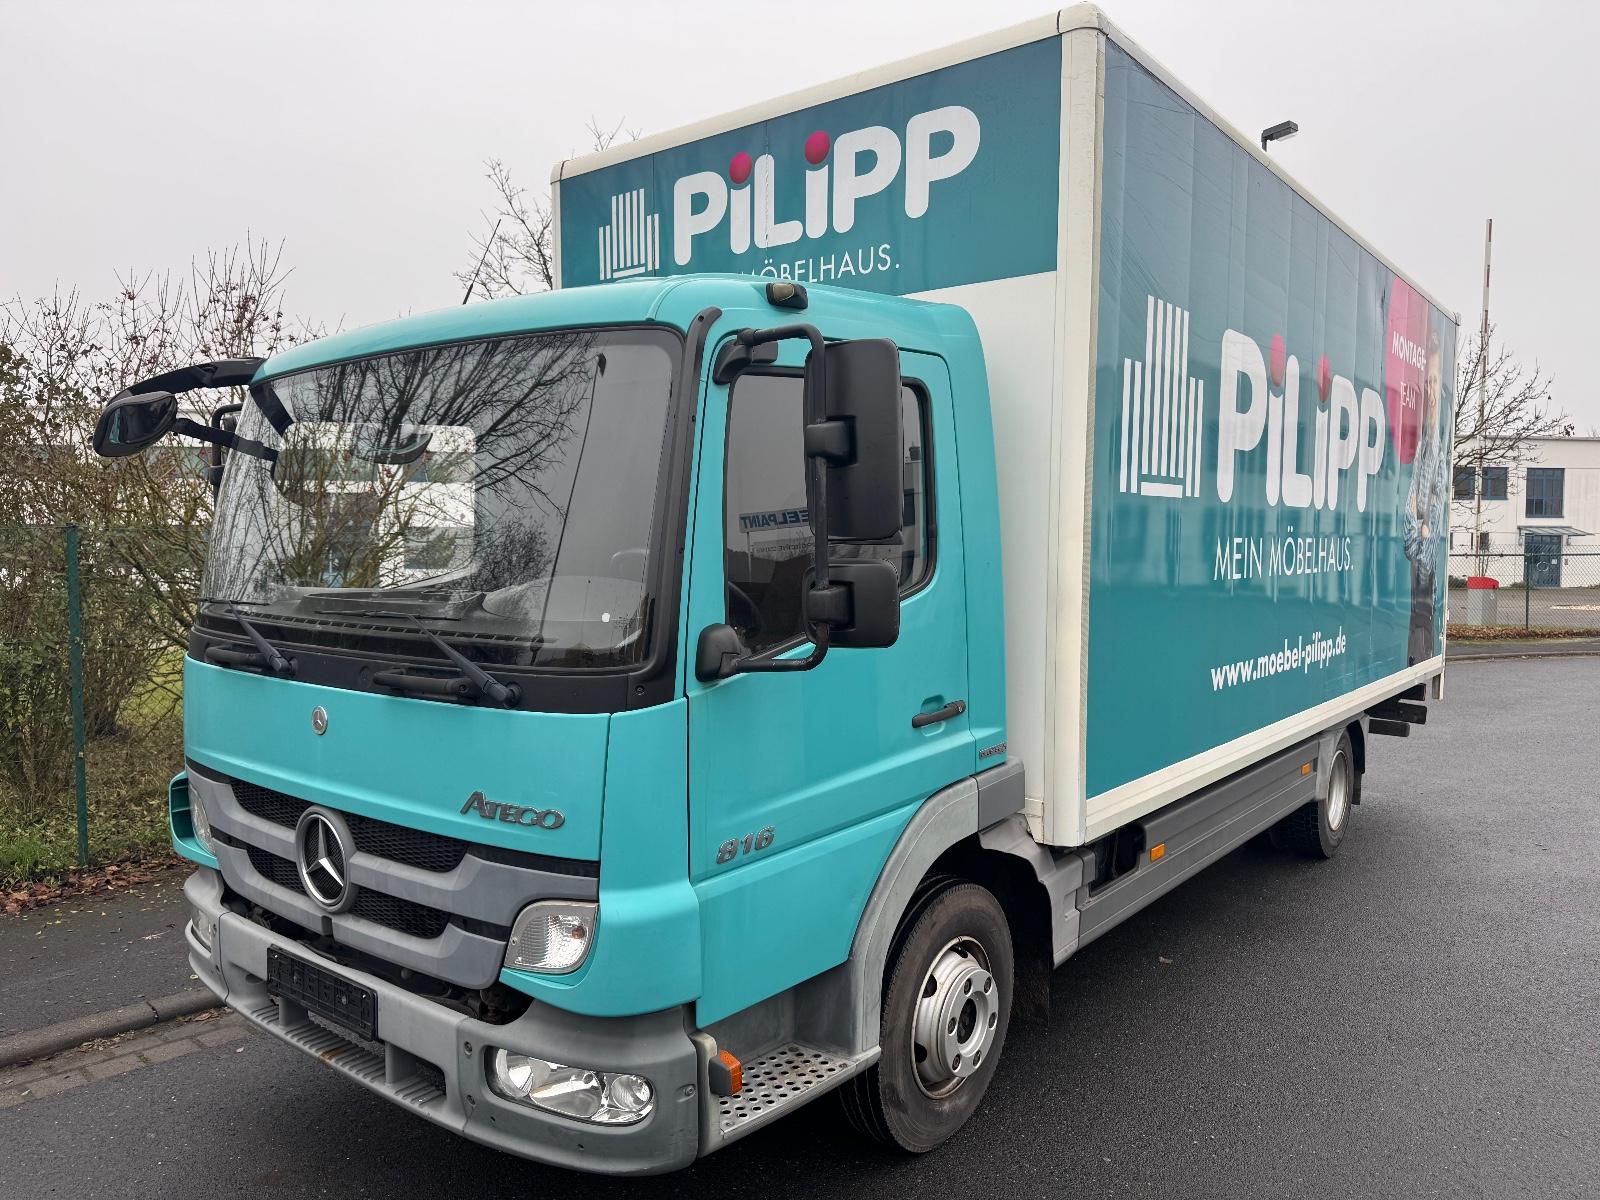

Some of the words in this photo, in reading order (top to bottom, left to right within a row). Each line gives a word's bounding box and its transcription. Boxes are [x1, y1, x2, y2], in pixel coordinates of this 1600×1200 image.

[741, 243, 900, 283] ÖBELHAUS.
[1400, 381, 1416, 411] TEAM
[1213, 536, 1263, 581] MEIN
[1268, 525, 1354, 577] MÖBELHAUS.
[1210, 625, 1346, 691] www.moebel-pilipp.de
[716, 825, 776, 865] 816
